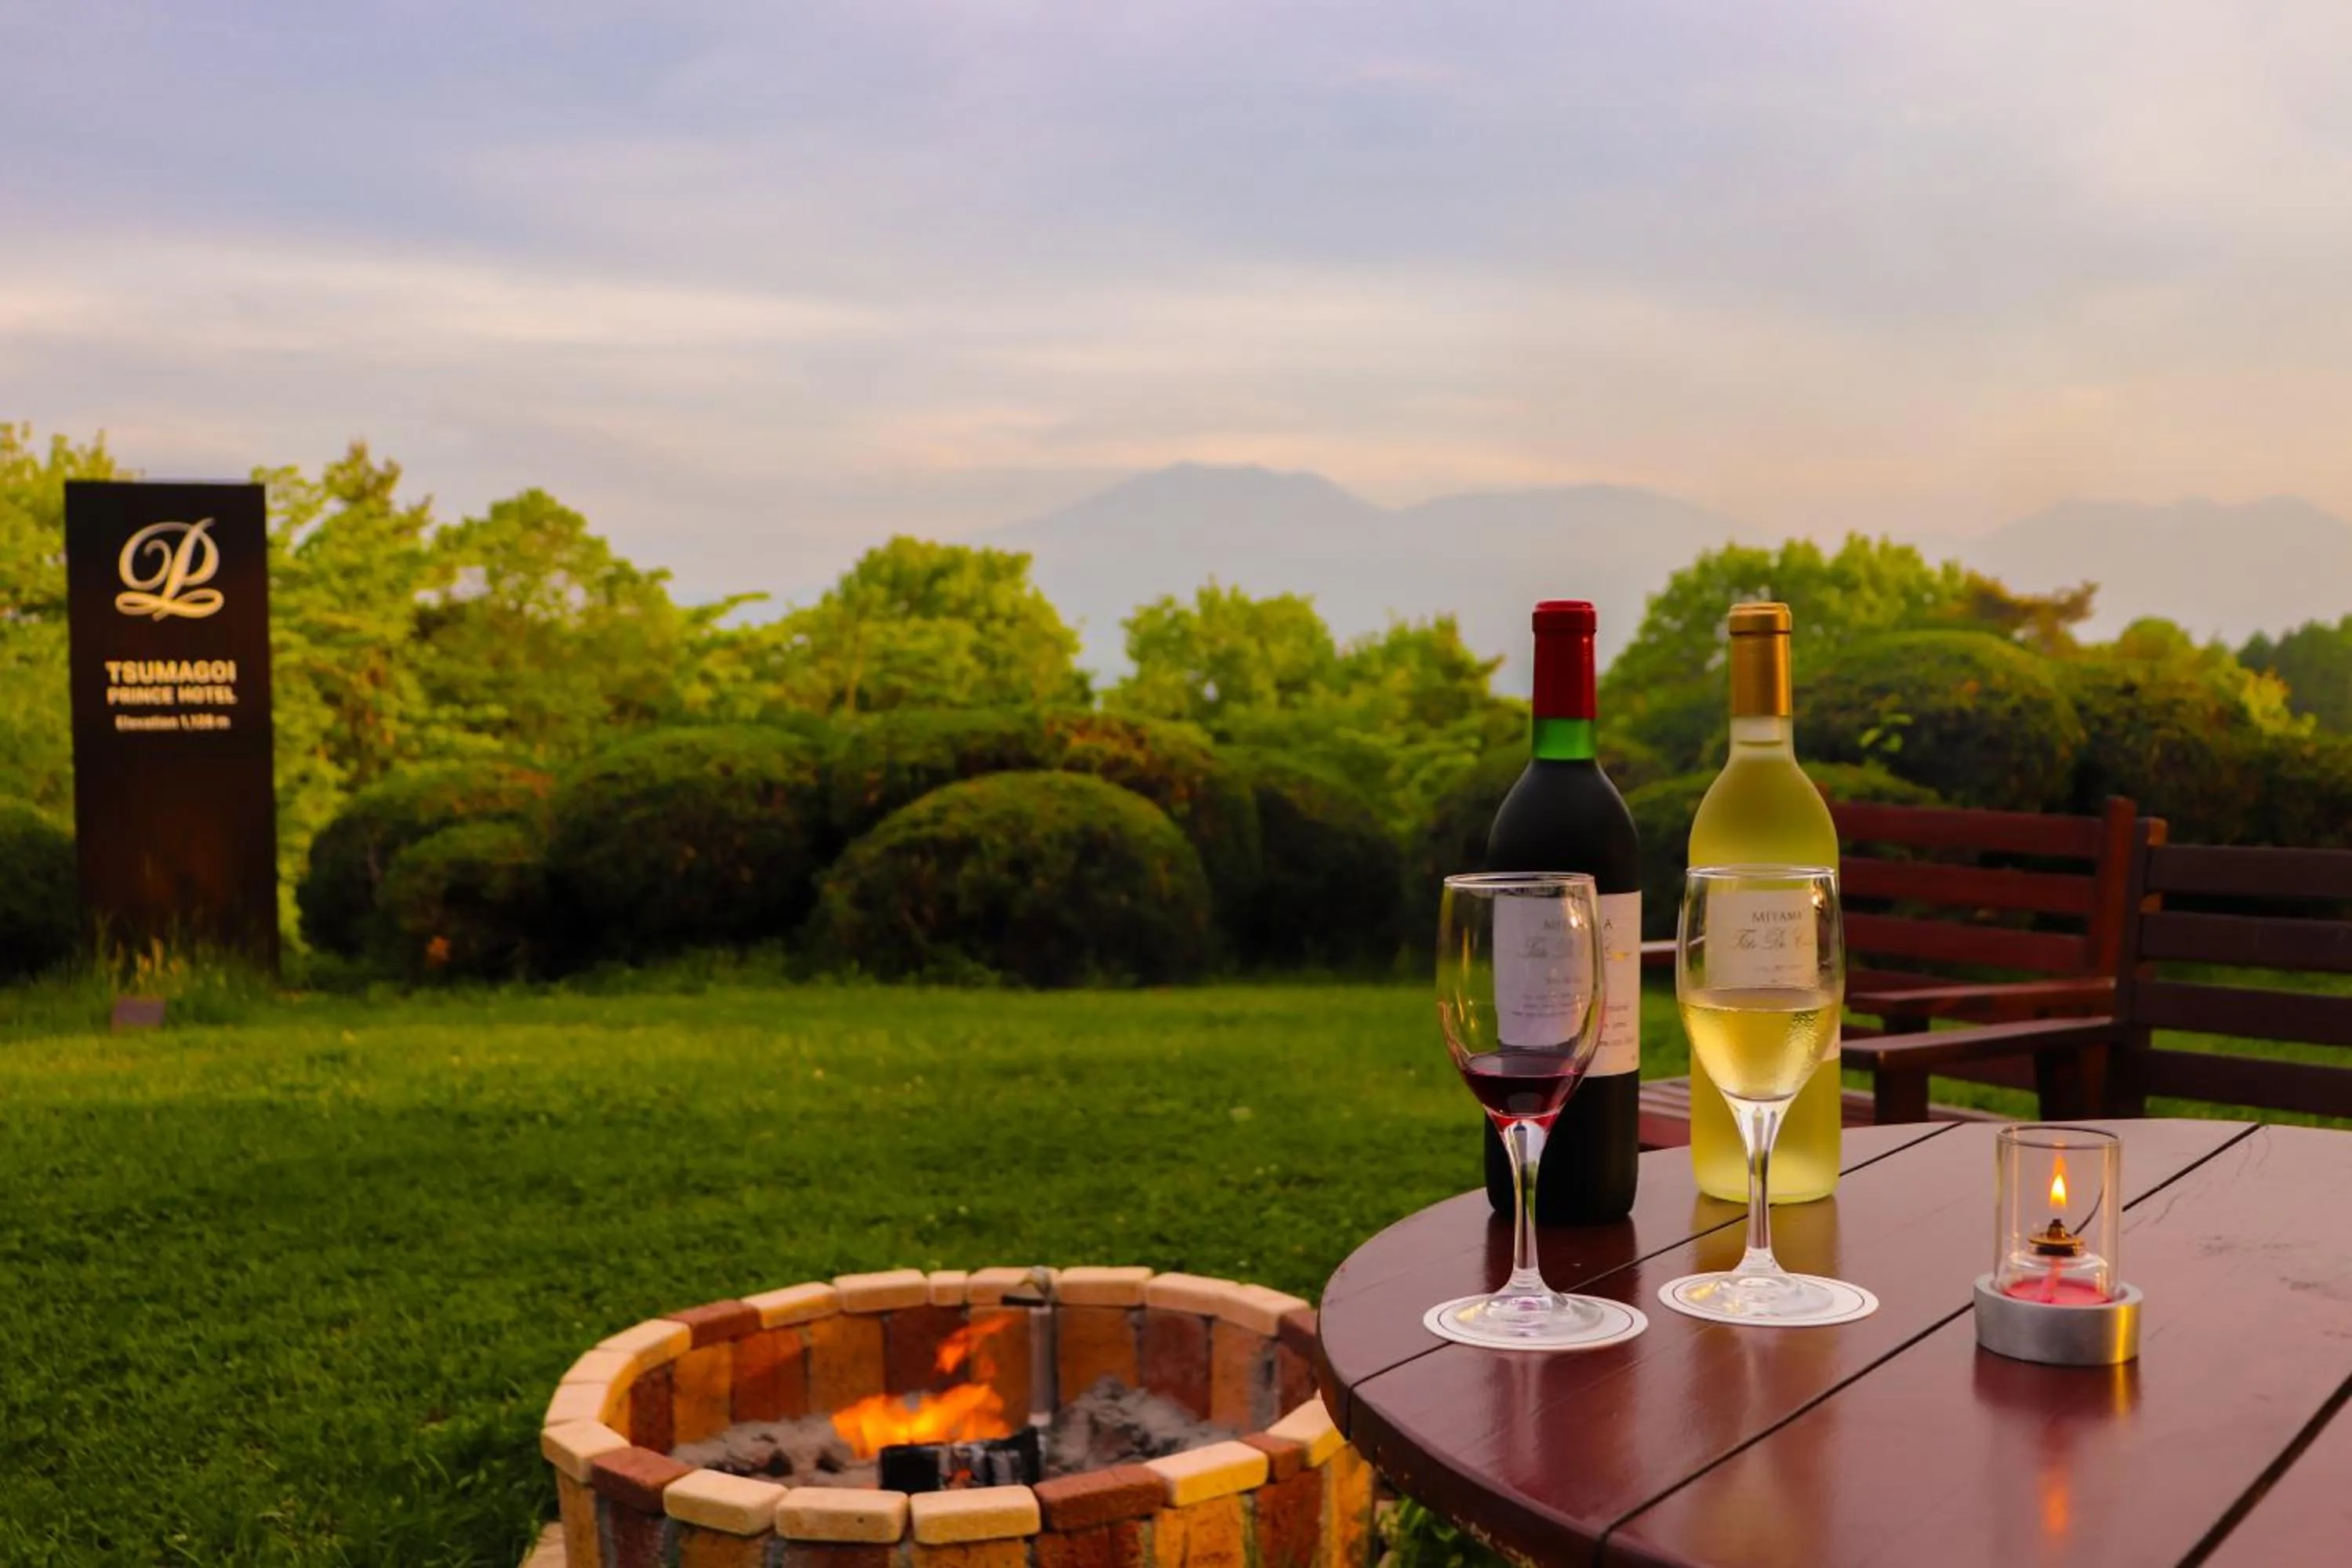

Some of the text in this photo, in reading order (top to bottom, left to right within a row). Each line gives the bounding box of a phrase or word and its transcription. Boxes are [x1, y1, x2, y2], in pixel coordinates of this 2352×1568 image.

[104, 659, 237, 684] TSUMAGOI
[107, 684, 238, 705] PRINCE HOTEL
